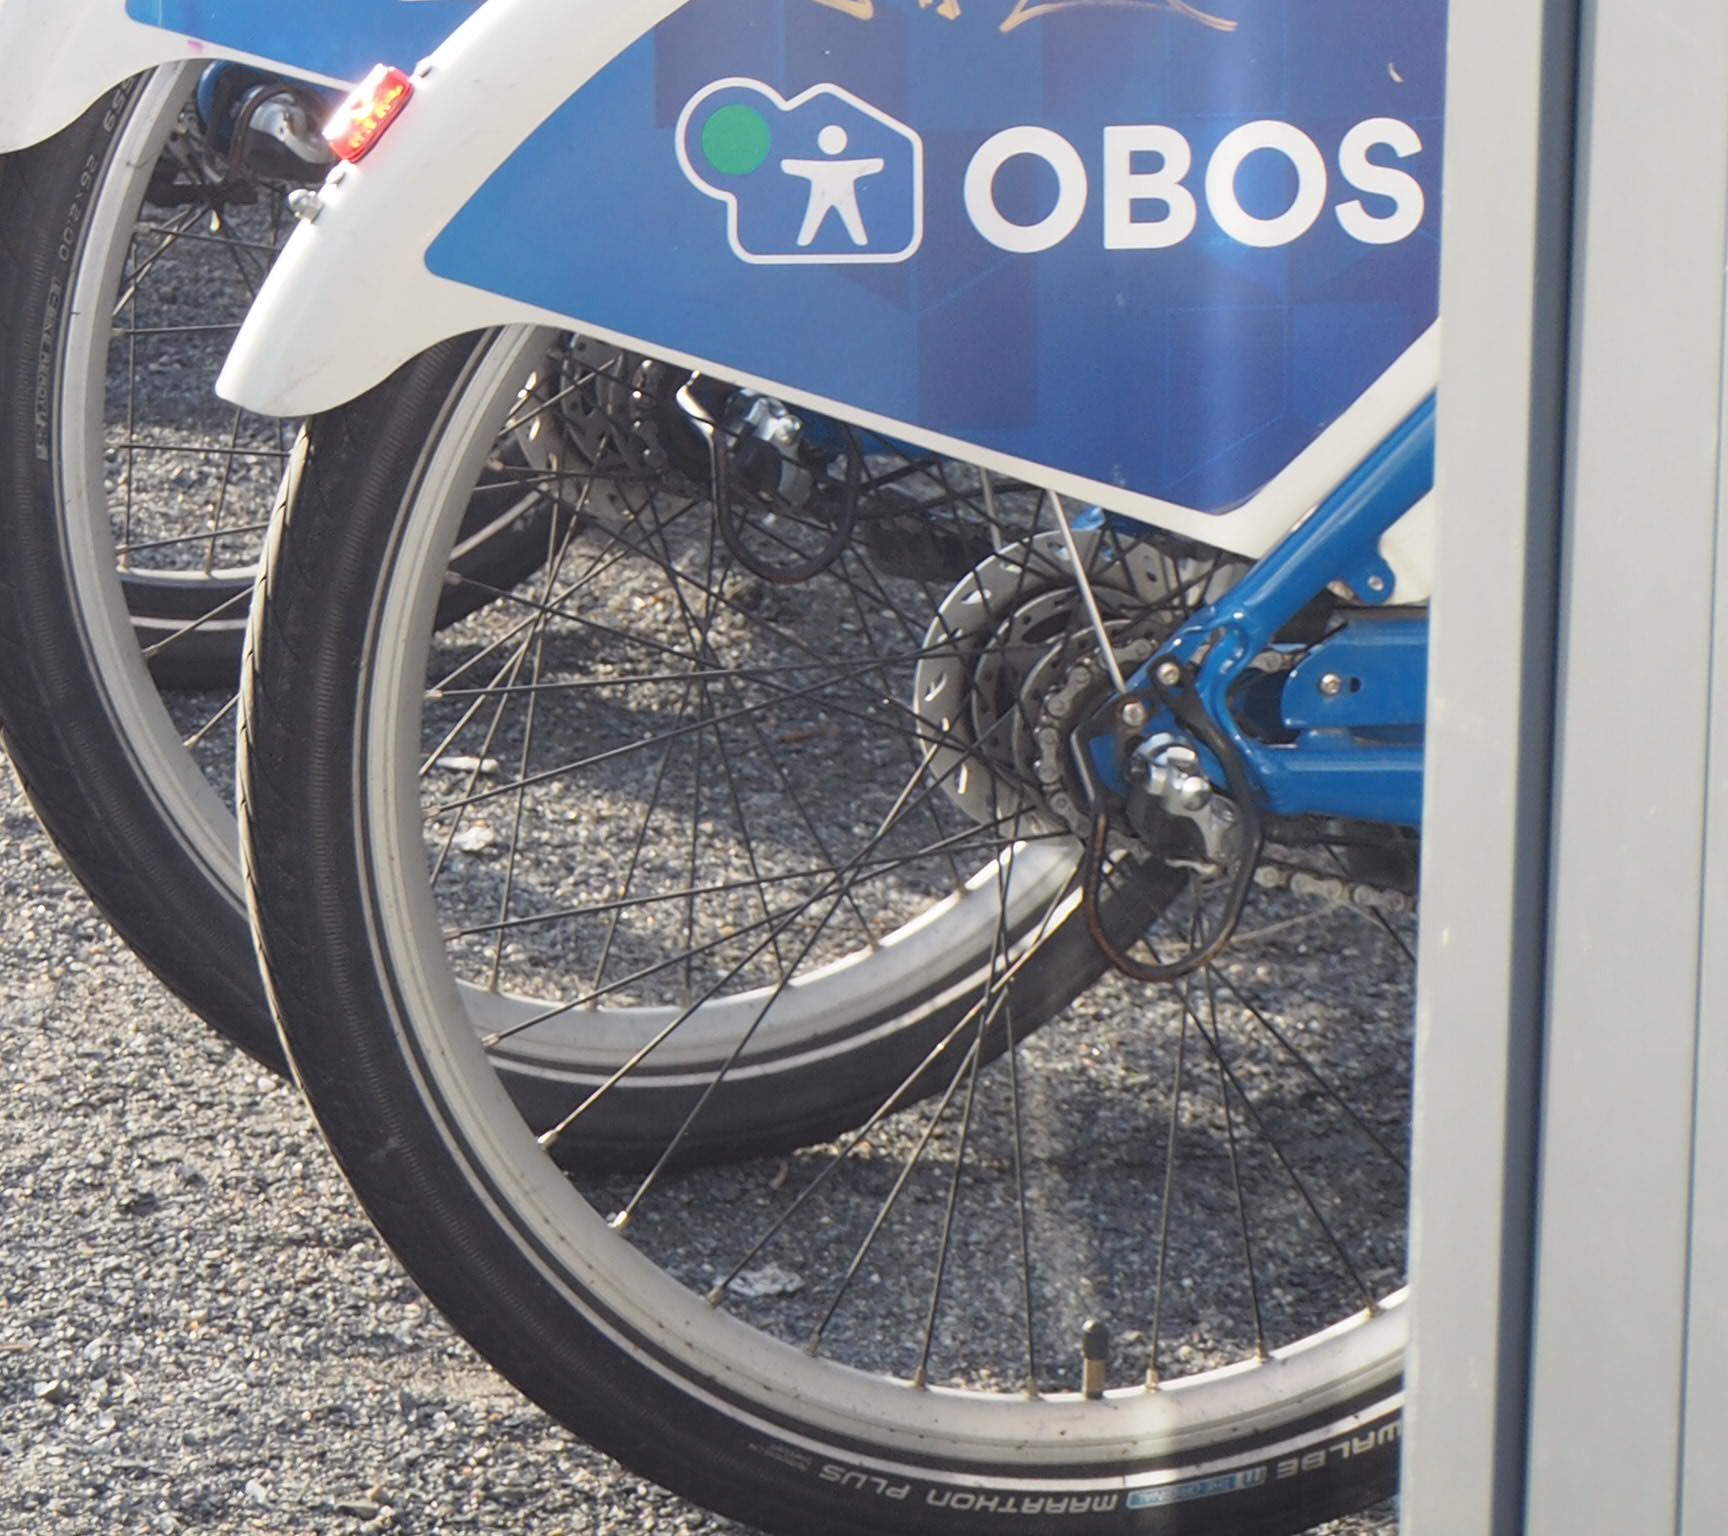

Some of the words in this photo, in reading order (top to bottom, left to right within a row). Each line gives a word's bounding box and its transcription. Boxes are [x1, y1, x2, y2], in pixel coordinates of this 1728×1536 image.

[963, 117, 1425, 254] OBOS
[819, 1464, 913, 1502] PLUS
[926, 1490, 1118, 1515] MARATHON
